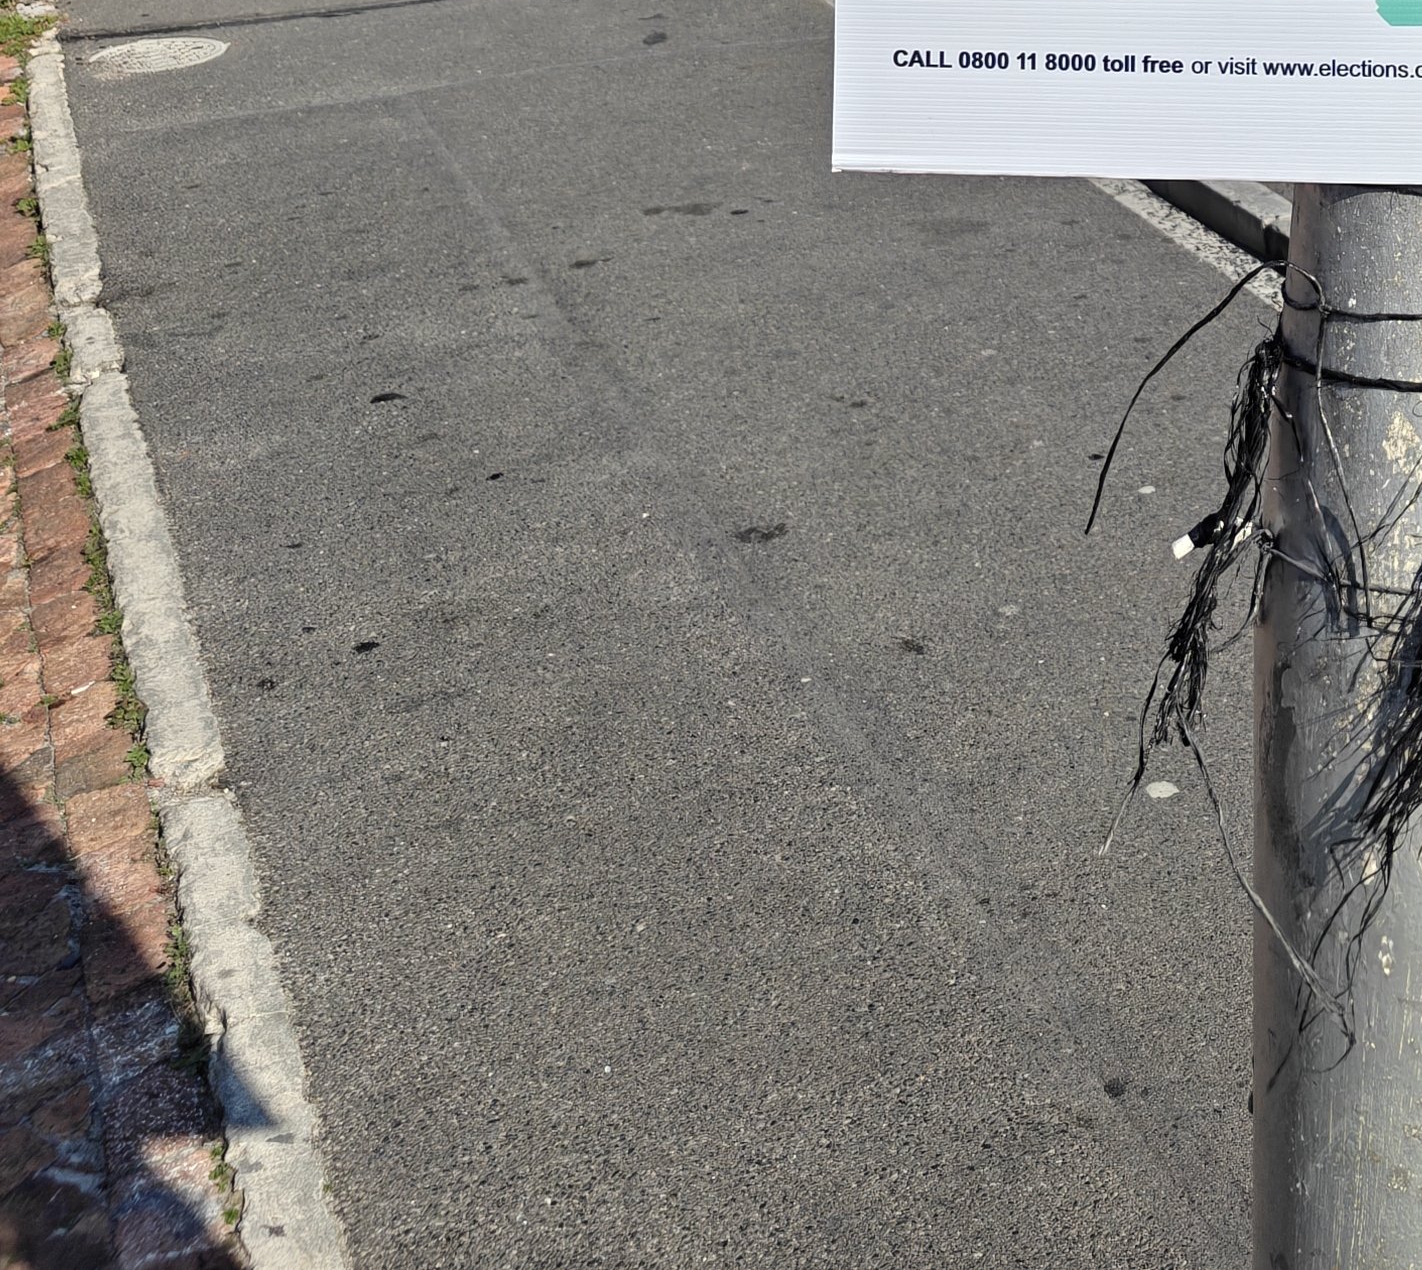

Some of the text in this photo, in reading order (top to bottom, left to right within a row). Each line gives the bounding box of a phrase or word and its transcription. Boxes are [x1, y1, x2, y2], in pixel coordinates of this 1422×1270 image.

[893, 49, 953, 69] CALL
[958, 51, 1009, 71] 0800
[1016, 52, 1037, 71] 11
[1045, 53, 1097, 72] 8000
[1102, 54, 1136, 73] toll
[1142, 55, 1185, 74] free
[1191, 59, 1213, 74] or
[1217, 58, 1258, 75] visit
